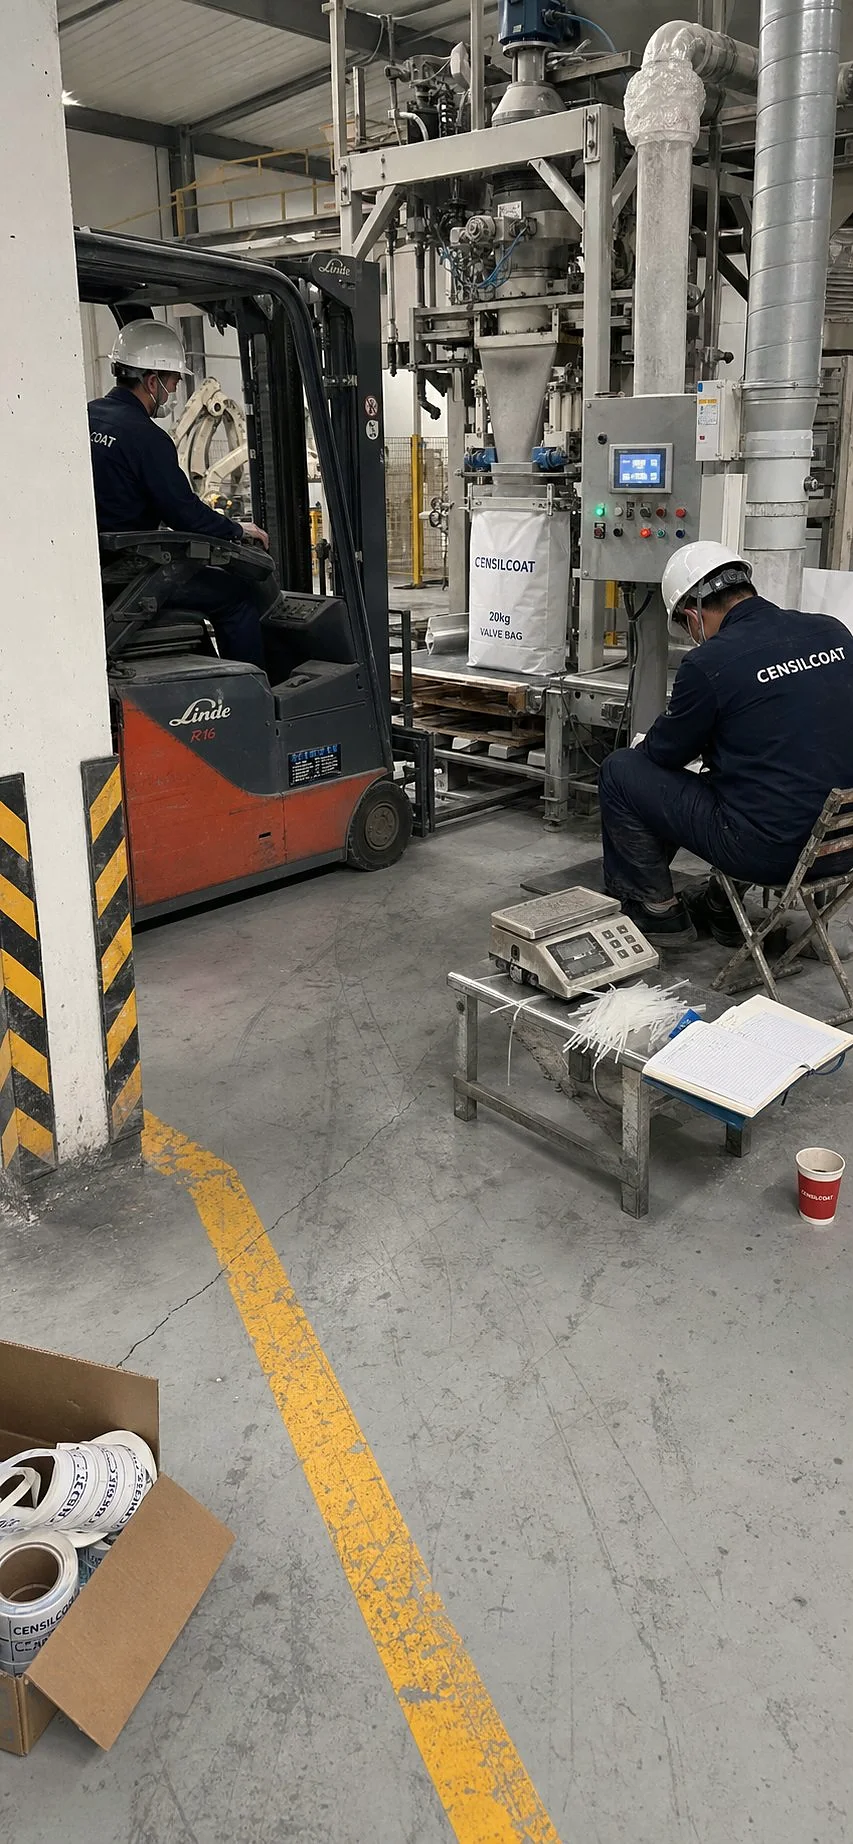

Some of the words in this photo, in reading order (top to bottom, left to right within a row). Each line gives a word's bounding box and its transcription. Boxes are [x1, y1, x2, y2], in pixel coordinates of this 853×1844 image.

[318, 258, 351, 276] Linde
[475, 556, 535, 573] CENSILCOAT
[489, 611, 511, 625] 20kg
[480, 627, 503, 638] VALVE
[504, 630, 523, 641] BAG
[756, 647, 846, 683] CENSILCOAT
[168, 698, 231, 727] Linde
[190, 728, 216, 743] R16
